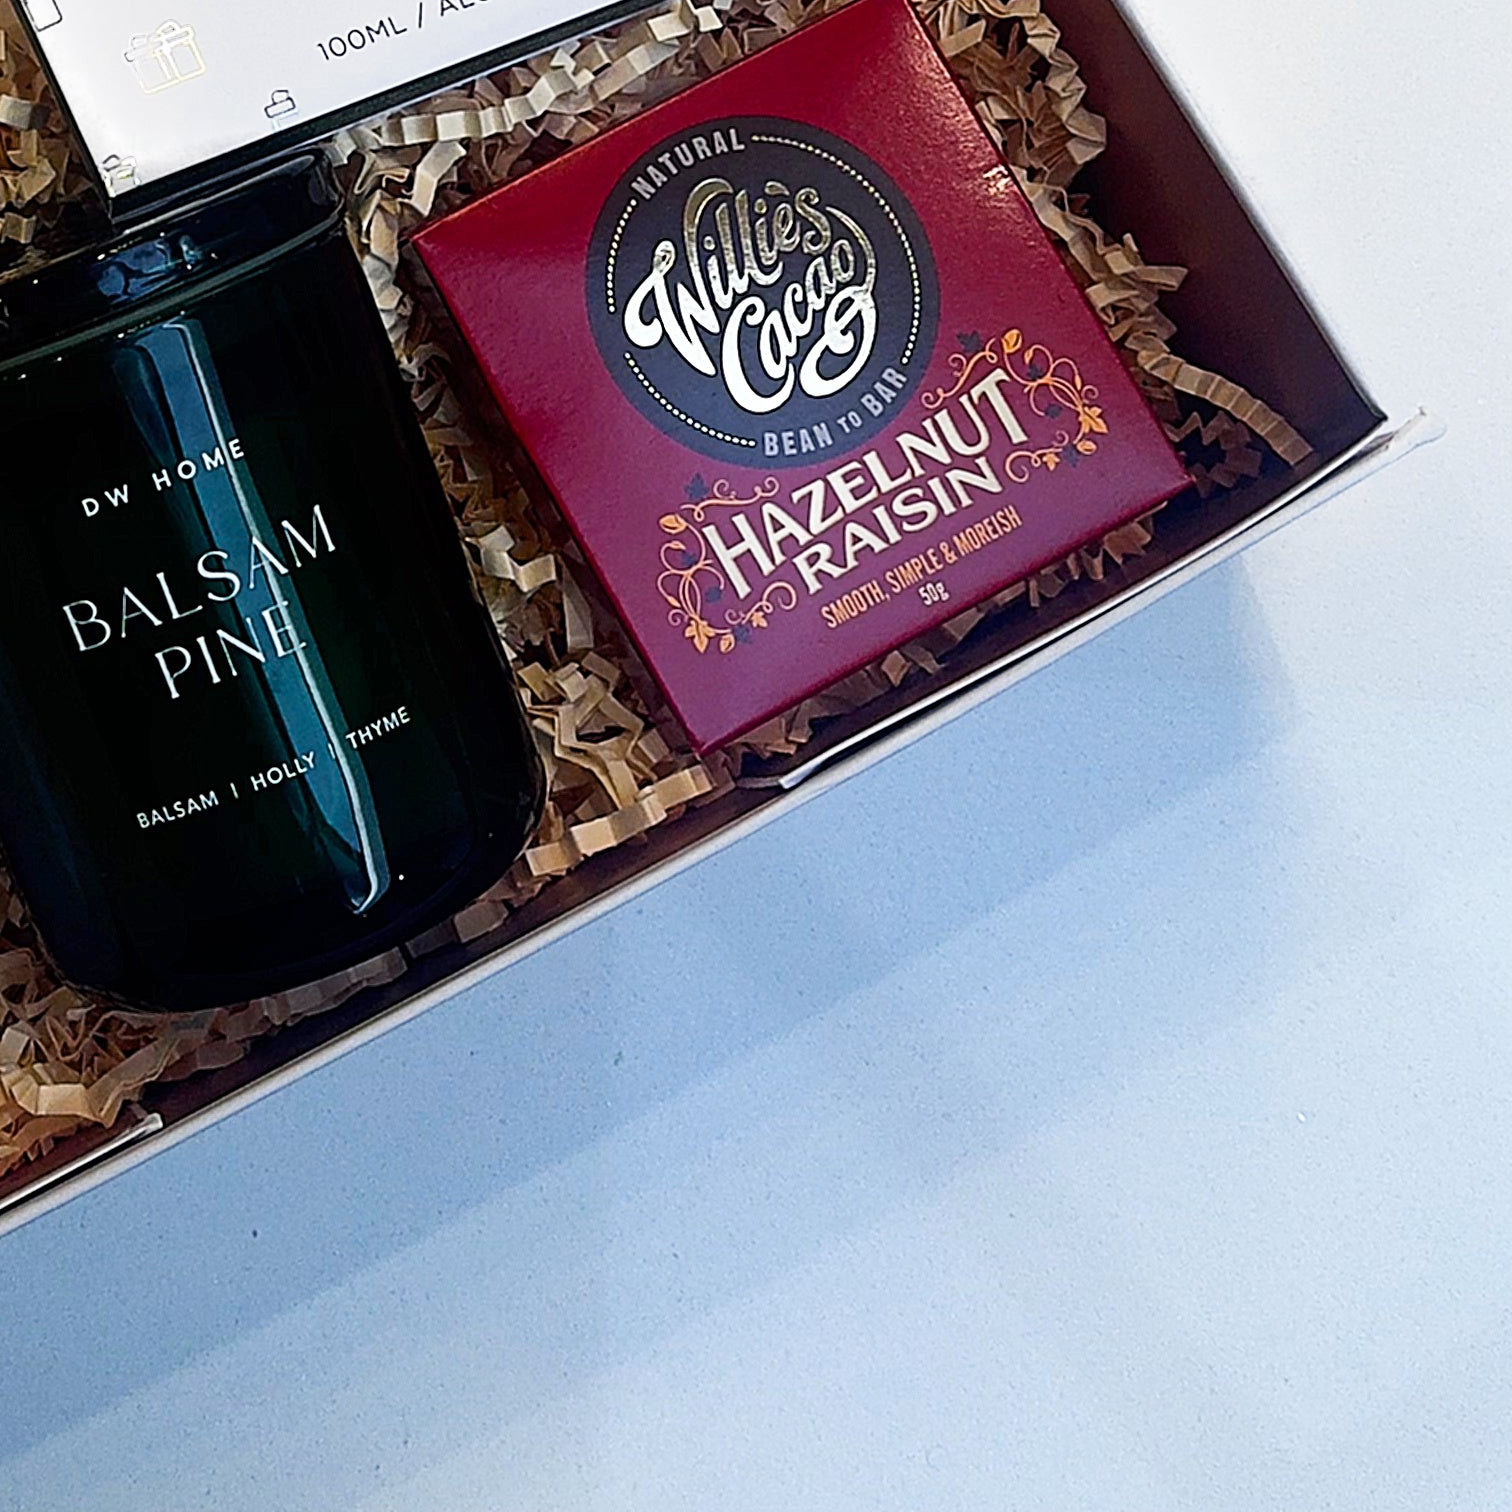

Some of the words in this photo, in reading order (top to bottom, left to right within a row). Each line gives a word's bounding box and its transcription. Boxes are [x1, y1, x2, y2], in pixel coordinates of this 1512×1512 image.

[317, 17, 407, 61] 100ML
[631, 128, 745, 200] NATURAL
[722, 233, 877, 414] Cacao
[763, 425, 834, 457] BEAN
[860, 366, 908, 418] BAR
[81, 484, 129, 517] DW
[152, 439, 245, 491] HOME
[702, 368, 1029, 598] HAZELNUT
[793, 456, 1002, 595] RAISIN
[62, 504, 336, 652] BALSAM
[821, 580, 890, 629] SMOOTH,
[884, 554, 943, 595] SIMPLE
[945, 544, 959, 565] &
[957, 505, 1023, 557] MOREISH
[918, 581, 950, 607] 50g
[155, 600, 307, 700] PINE
[136, 791, 219, 829] BALSAM
[250, 751, 316, 791] HOLLY
[345, 705, 411, 750] THYME
